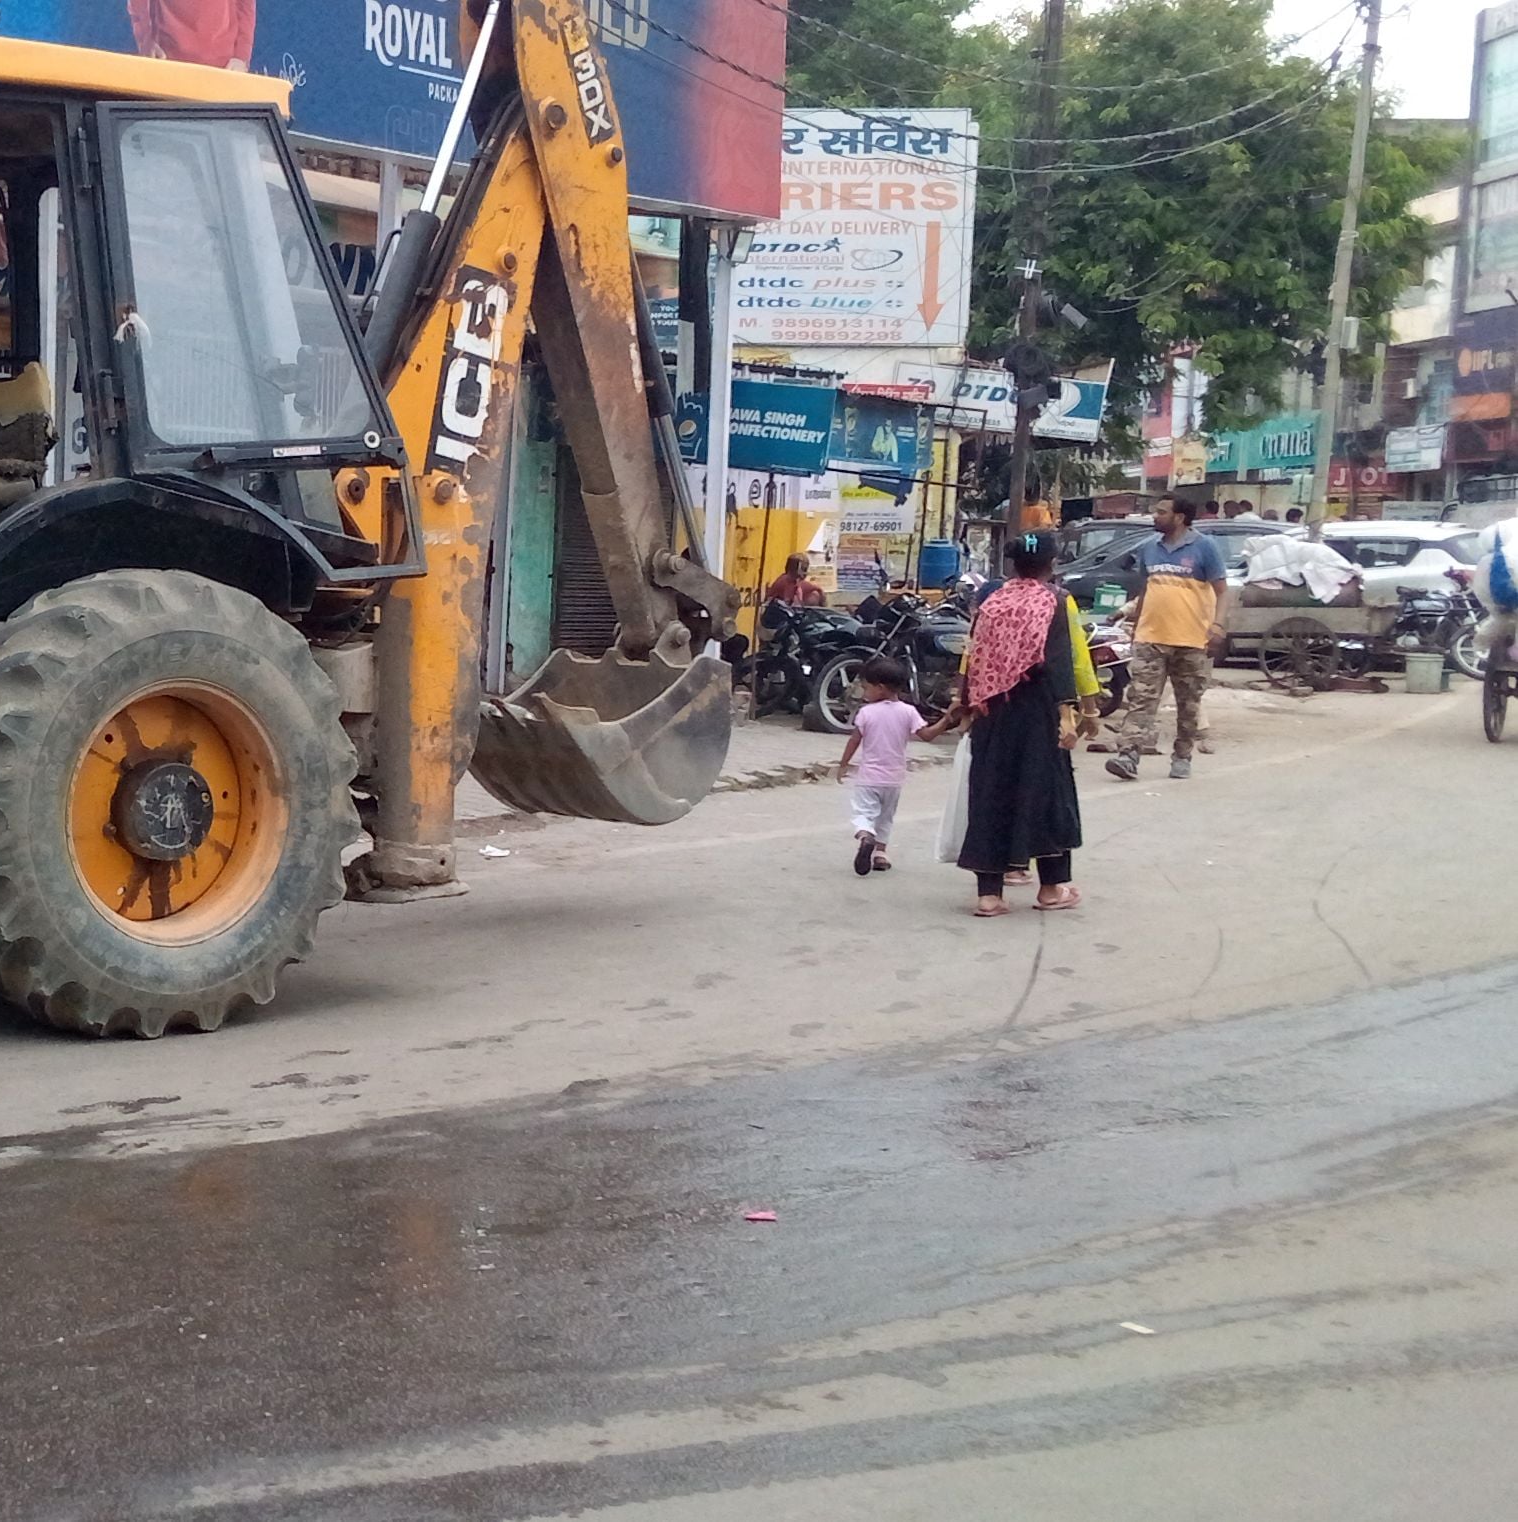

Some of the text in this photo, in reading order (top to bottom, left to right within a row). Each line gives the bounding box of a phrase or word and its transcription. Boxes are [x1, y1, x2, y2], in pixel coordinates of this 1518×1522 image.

[364, 0, 453, 70] ROYAL
[427, 82, 460, 103] PACKA
[572, 52, 613, 138] 3DX
[818, 116, 953, 155] सर्विस
[782, 181, 959, 211] RIERS
[753, 221, 912, 235] EXT DAY DELIVERY
[751, 242, 822, 253] DTDC
[748, 254, 845, 263] nternational
[737, 277, 877, 291] dtdc plus
[737, 296, 873, 308] dtdc blue
[729, 409, 807, 428] AWA SINGH
